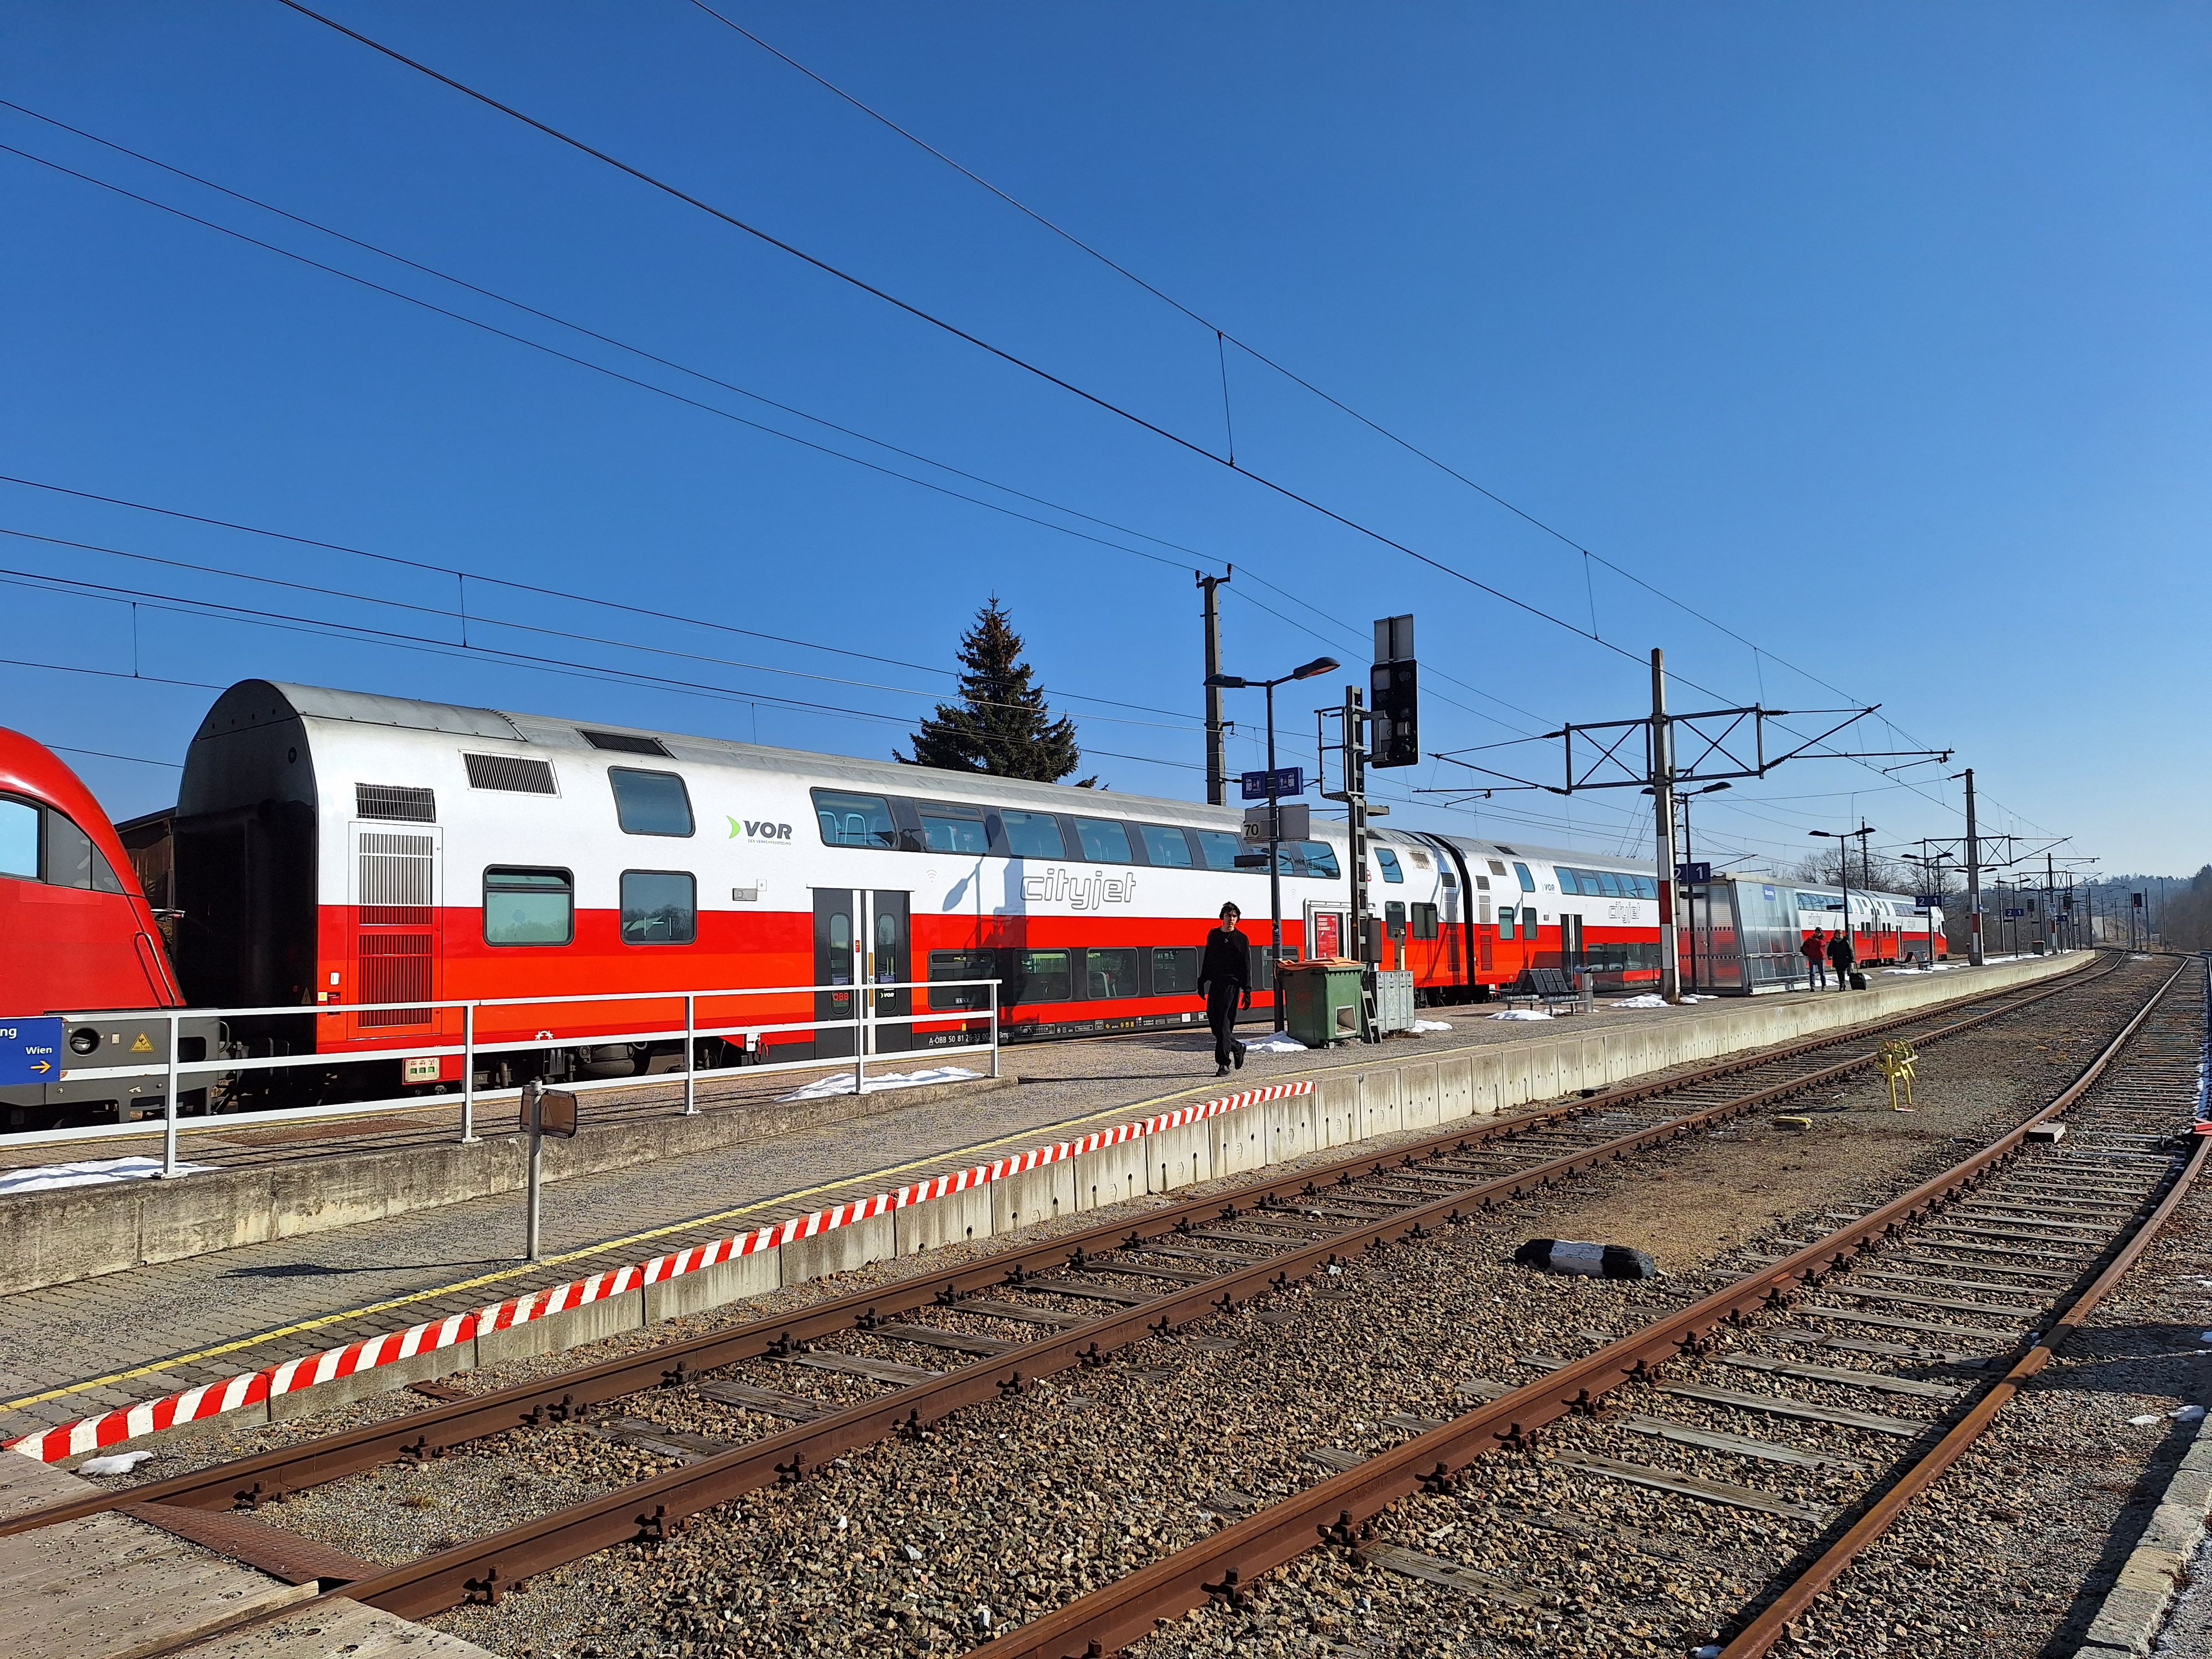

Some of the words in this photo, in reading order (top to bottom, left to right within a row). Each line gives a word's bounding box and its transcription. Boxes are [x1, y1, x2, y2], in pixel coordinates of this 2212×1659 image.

[743, 820, 792, 839] VOR
[1244, 823, 1259, 836] 70
[1674, 868, 1682, 880] 2
[1695, 866, 1703, 879] 1
[1020, 868, 1136, 910] cityjet
[1545, 883, 1555, 892] VOR
[1608, 901, 1641, 924] cityjet
[833, 992, 849, 1001] ÖBB
[928, 1035, 947, 1045] A-ÖBB
[25, 1046, 53, 1055] Wien
